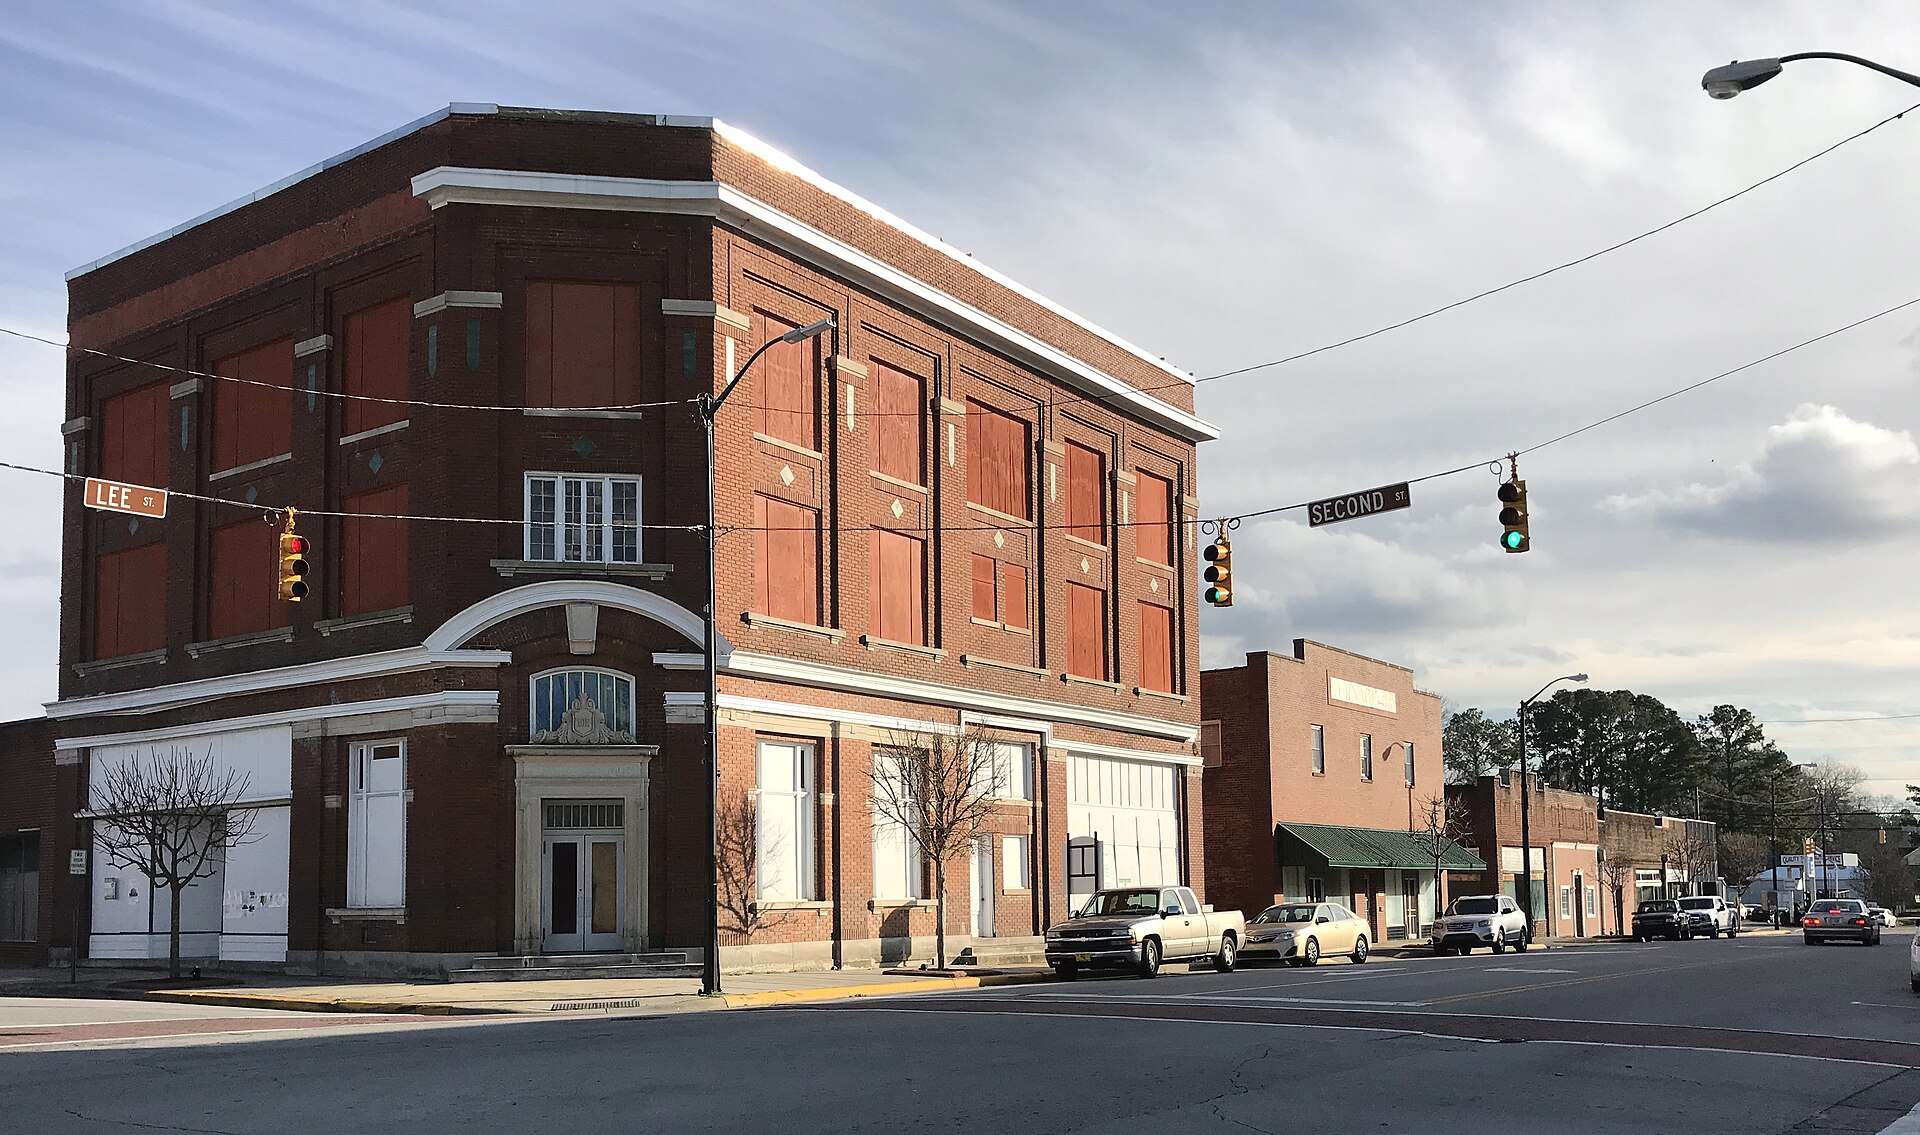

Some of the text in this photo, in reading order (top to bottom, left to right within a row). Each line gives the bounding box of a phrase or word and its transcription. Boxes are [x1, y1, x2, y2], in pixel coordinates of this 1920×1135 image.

[96, 483, 155, 509] LEE ST.
[1312, 490, 1407, 523] SECOND ST.
[1825, 855, 1841, 863] ERVICE
